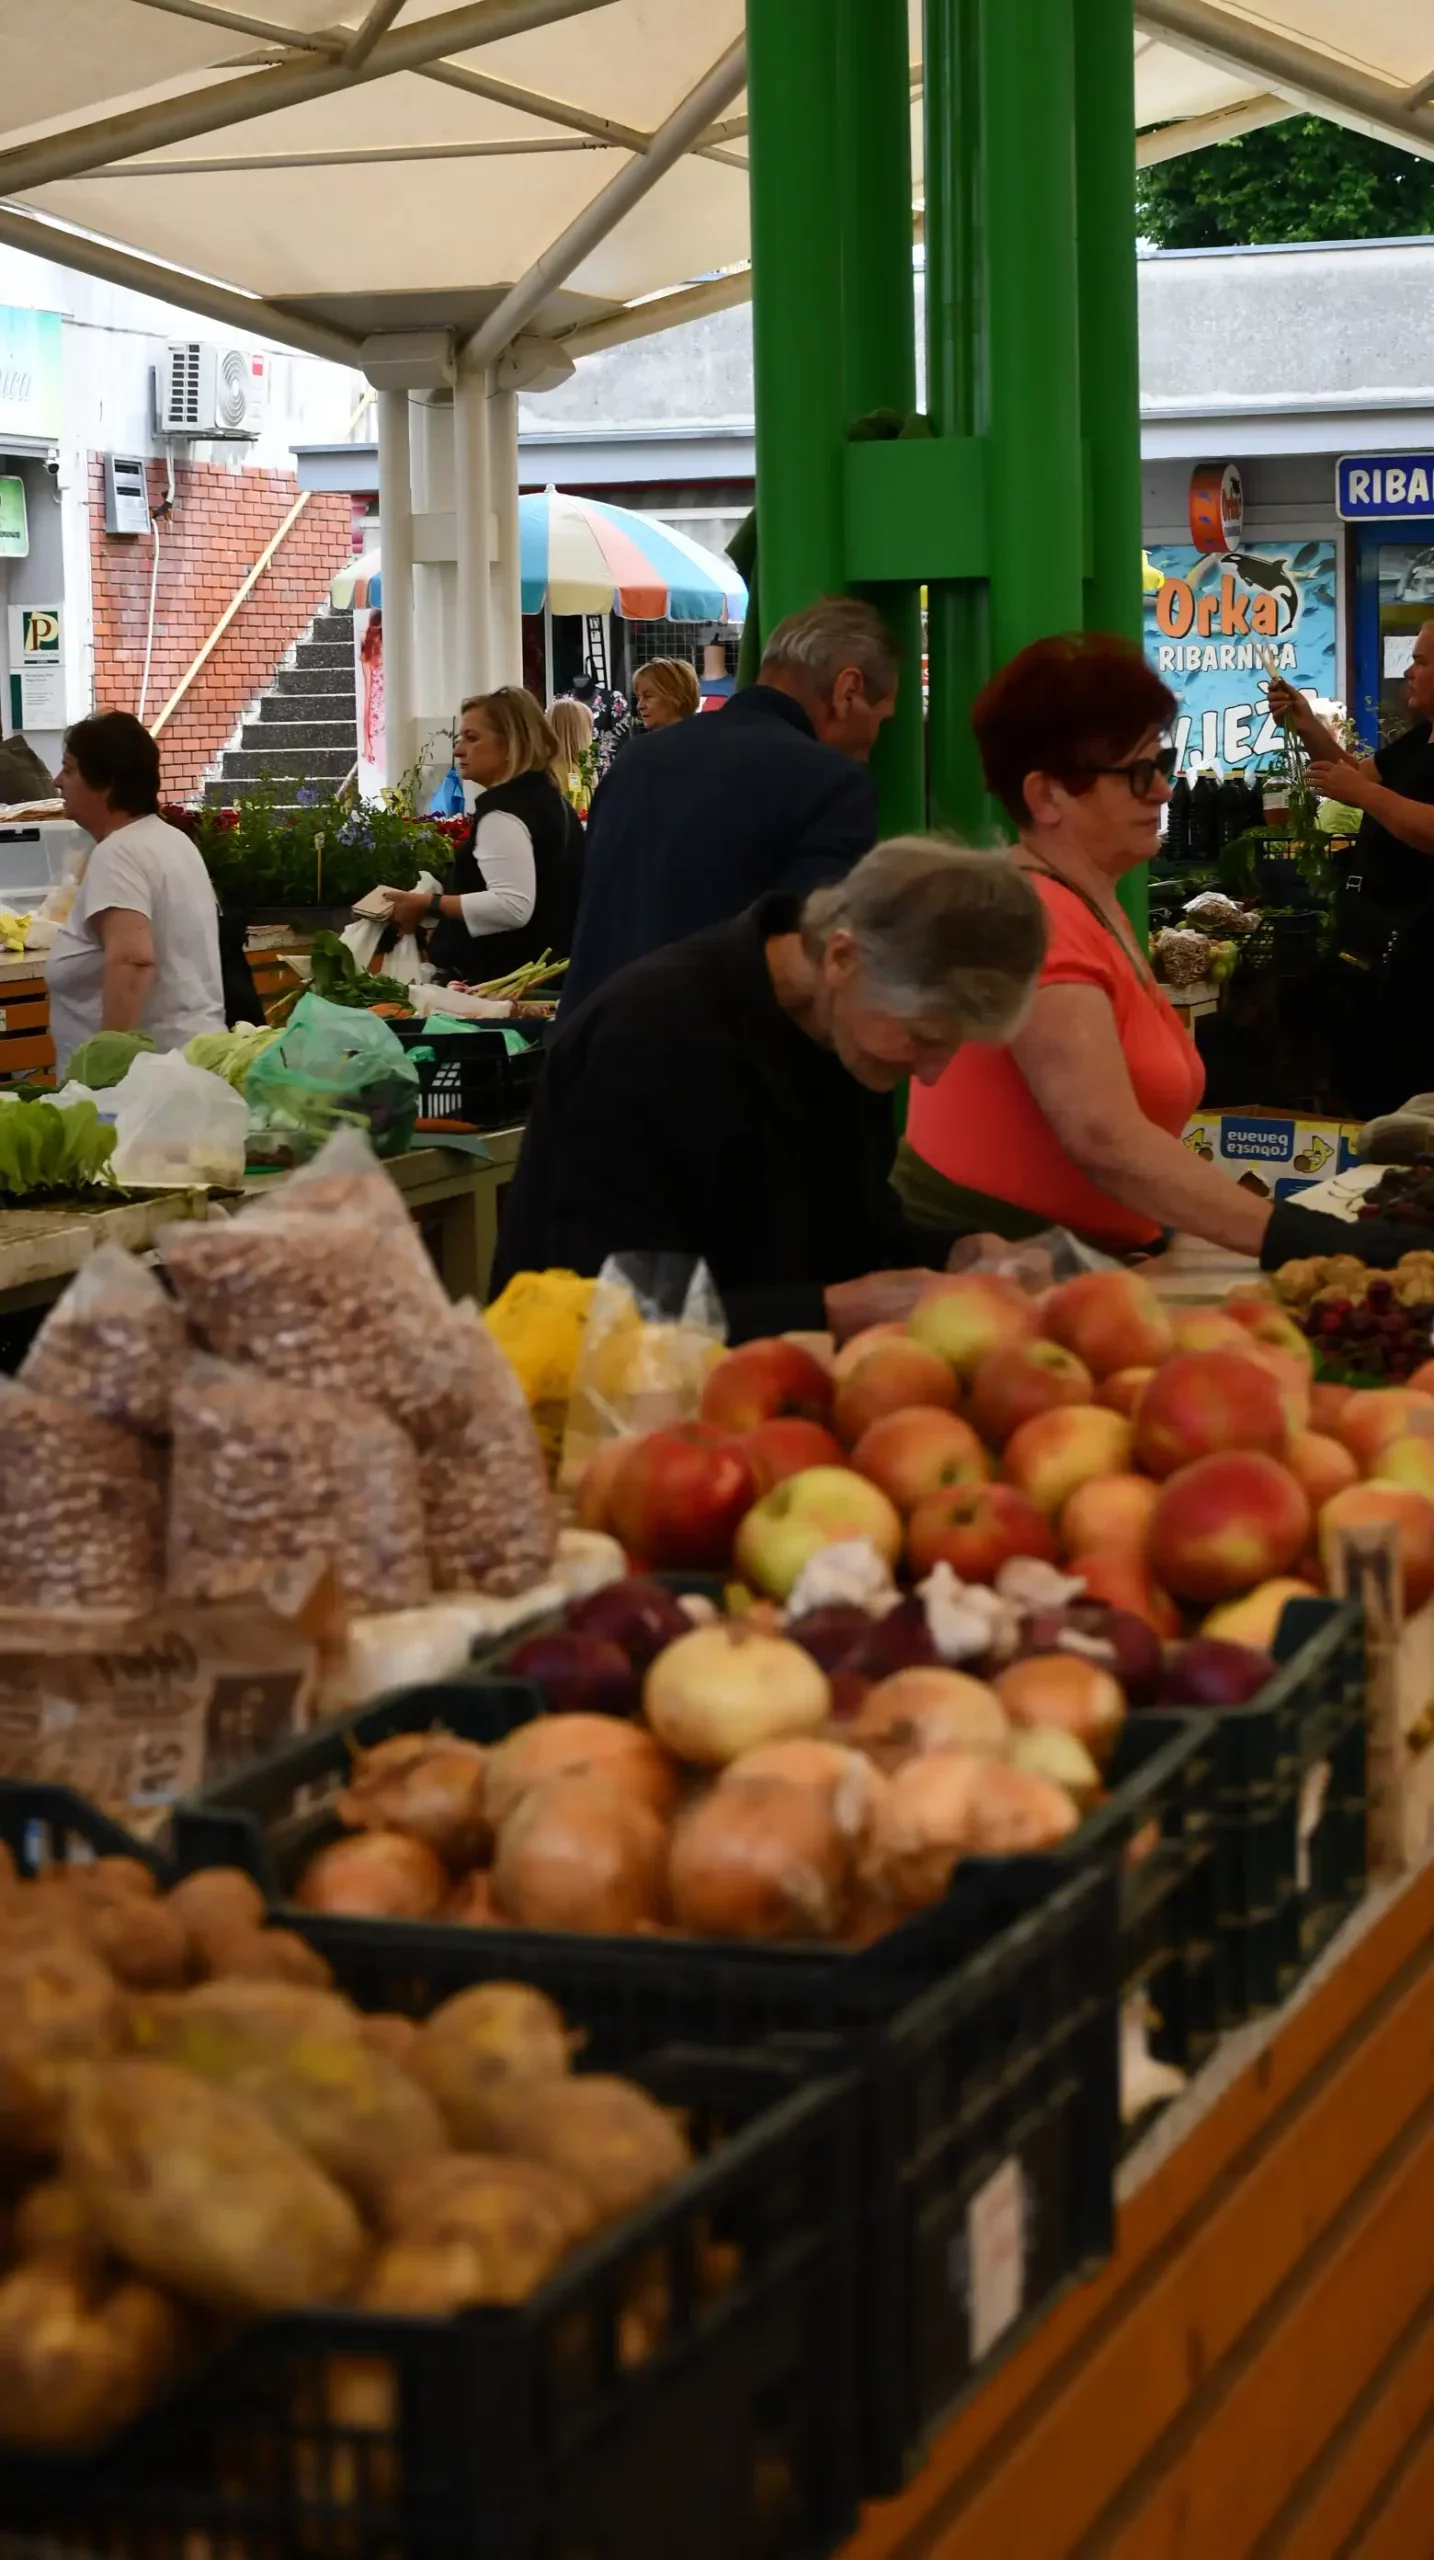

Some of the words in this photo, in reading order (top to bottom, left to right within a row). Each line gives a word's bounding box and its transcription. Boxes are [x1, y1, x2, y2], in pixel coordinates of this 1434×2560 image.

[1349, 467, 1434, 505] RIBA
[1156, 574, 1278, 638] Orka
[1227, 1143, 1287, 1156] robusta
[1228, 1131, 1288, 1146] banana
